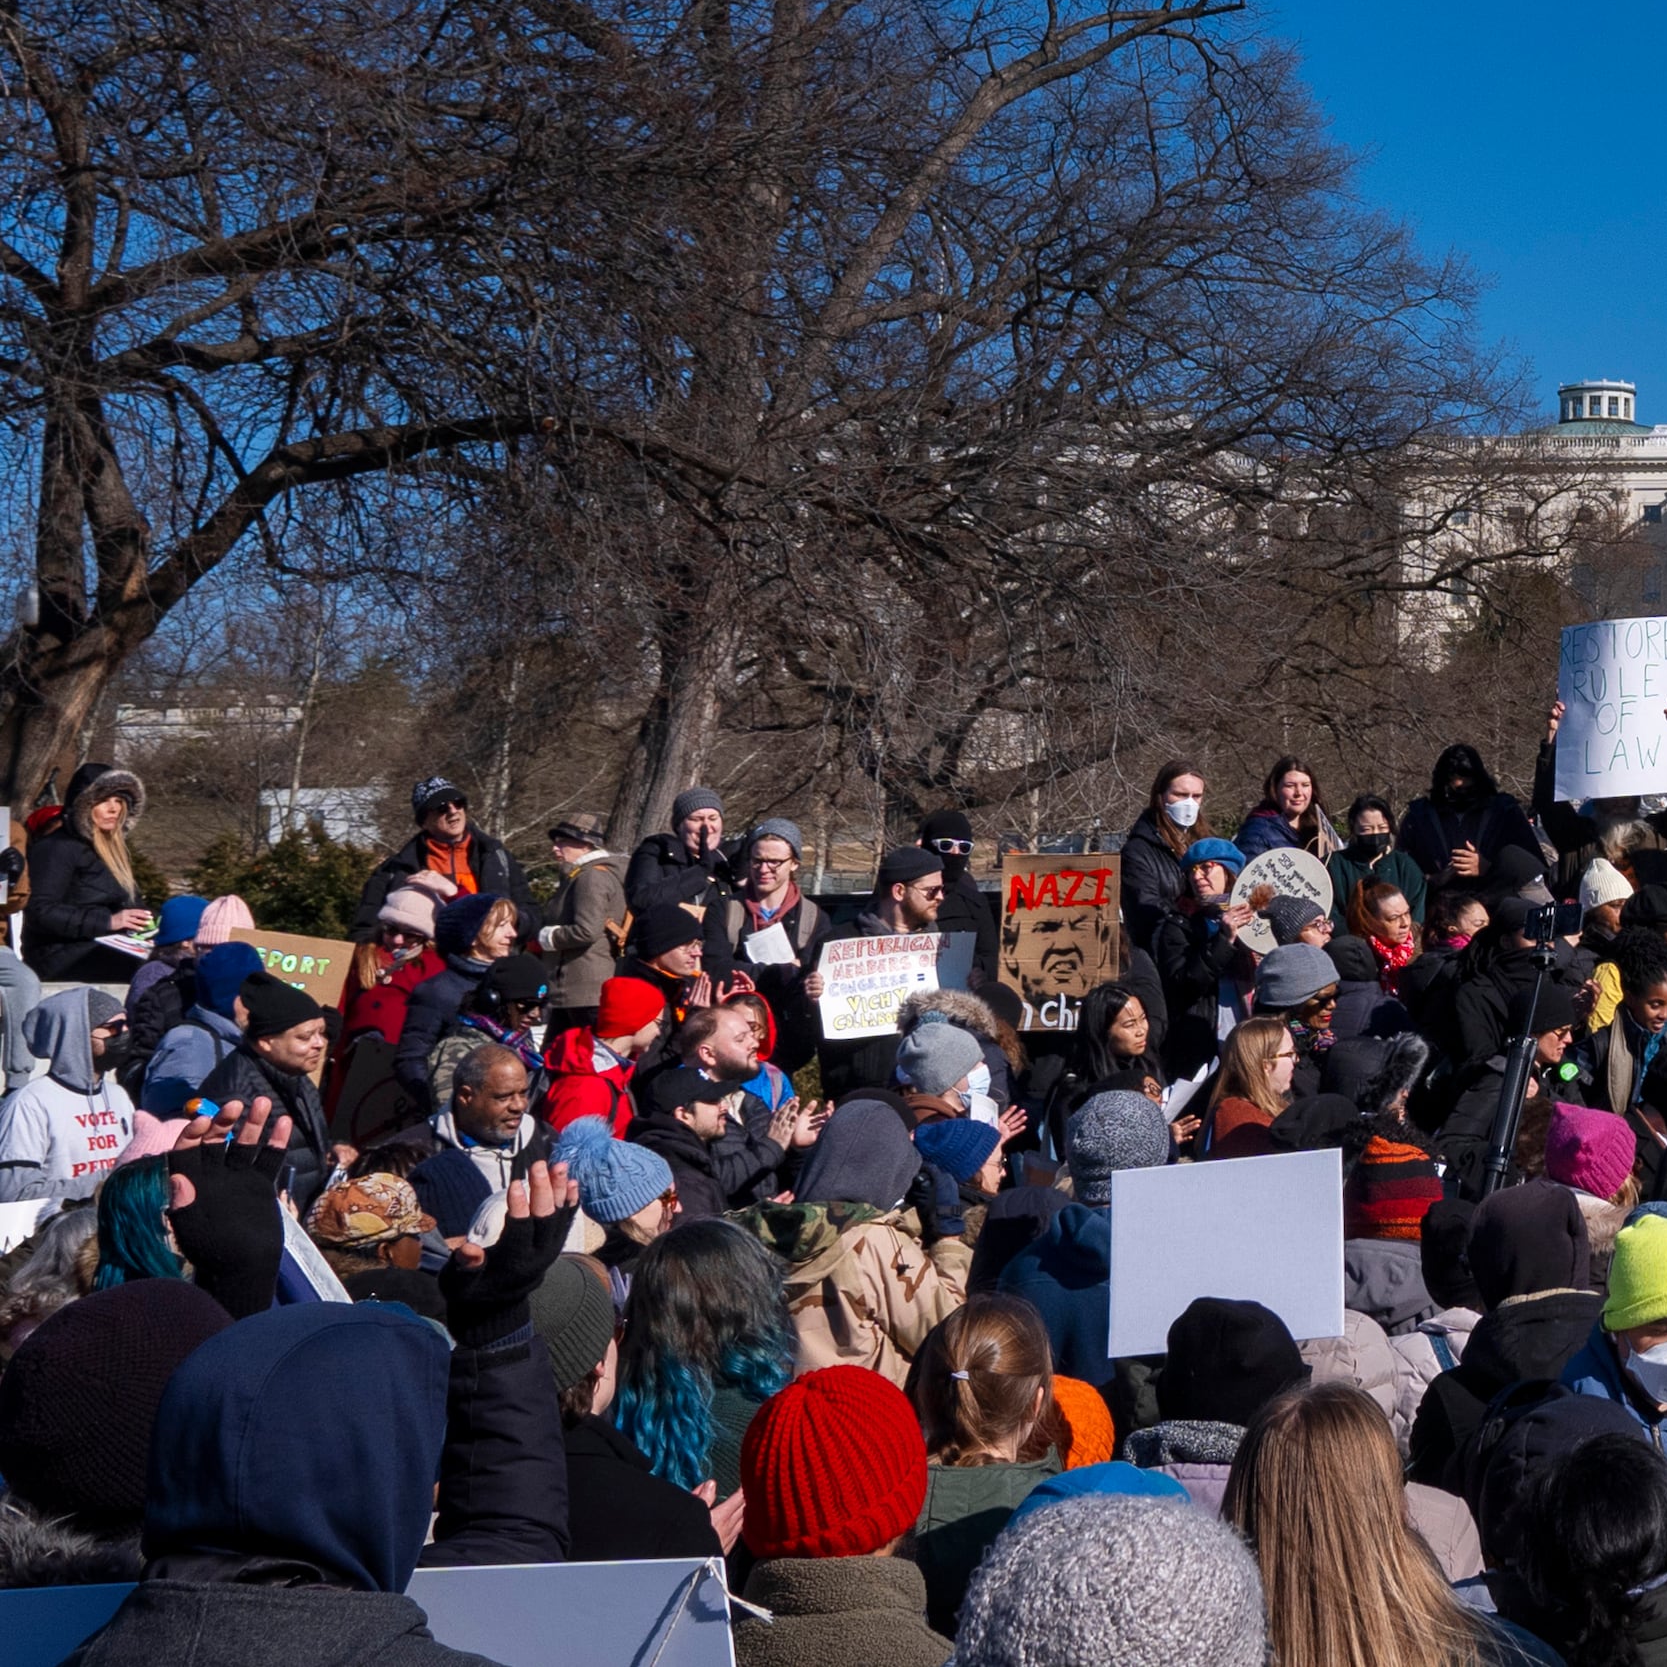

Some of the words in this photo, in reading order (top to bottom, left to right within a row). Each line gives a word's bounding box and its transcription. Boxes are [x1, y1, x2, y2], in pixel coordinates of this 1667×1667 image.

[1573, 664, 1659, 703] RULE
[1596, 701, 1636, 735] OF
[1585, 735, 1661, 774] LAW
[1008, 868, 1113, 915] NAZI
[257, 947, 330, 976] EPORT
[828, 934, 950, 964] REPUBLICAN
[832, 955, 911, 981] MEMBERS
[847, 987, 909, 1014] VICHY
[1040, 992, 1082, 1031] Chi
[76, 1111, 118, 1128] VOTE
[88, 1135, 118, 1151] FOR
